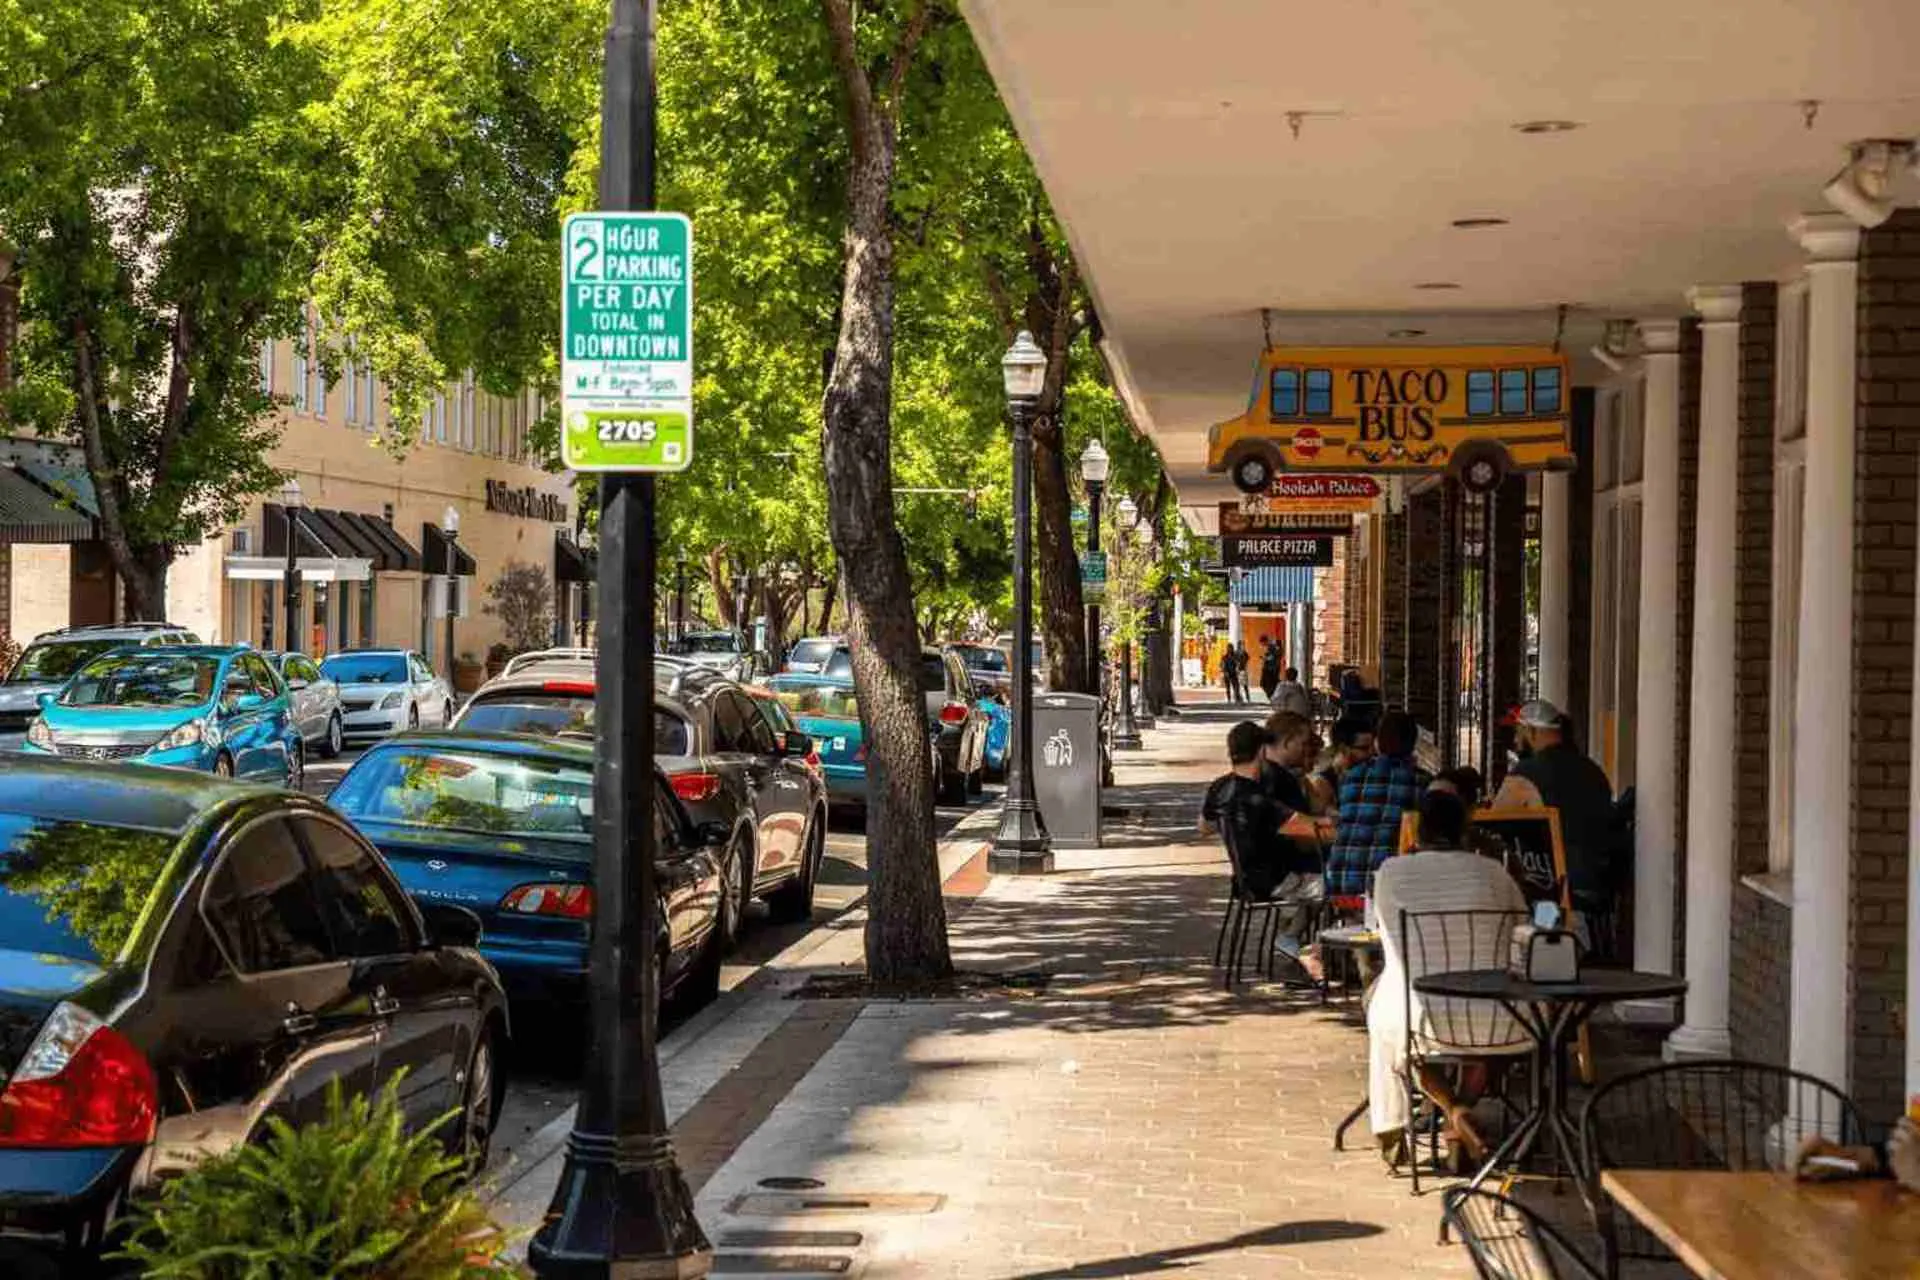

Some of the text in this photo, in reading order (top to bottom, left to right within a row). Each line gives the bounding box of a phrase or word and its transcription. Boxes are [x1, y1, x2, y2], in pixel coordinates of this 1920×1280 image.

[575, 236, 599, 279] 2
[606, 254, 681, 280] PARKING
[577, 285, 677, 310] PER DAY
[591, 312, 665, 331] TOTAL IN
[573, 333, 680, 358] DOWNTOWN
[1346, 368, 1448, 405] TACO
[598, 419, 657, 441] 2705
[1358, 405, 1434, 442] BUS
[1271, 479, 1370, 496] Hookah Palace
[1238, 539, 1317, 554] PALACE PIZZA
